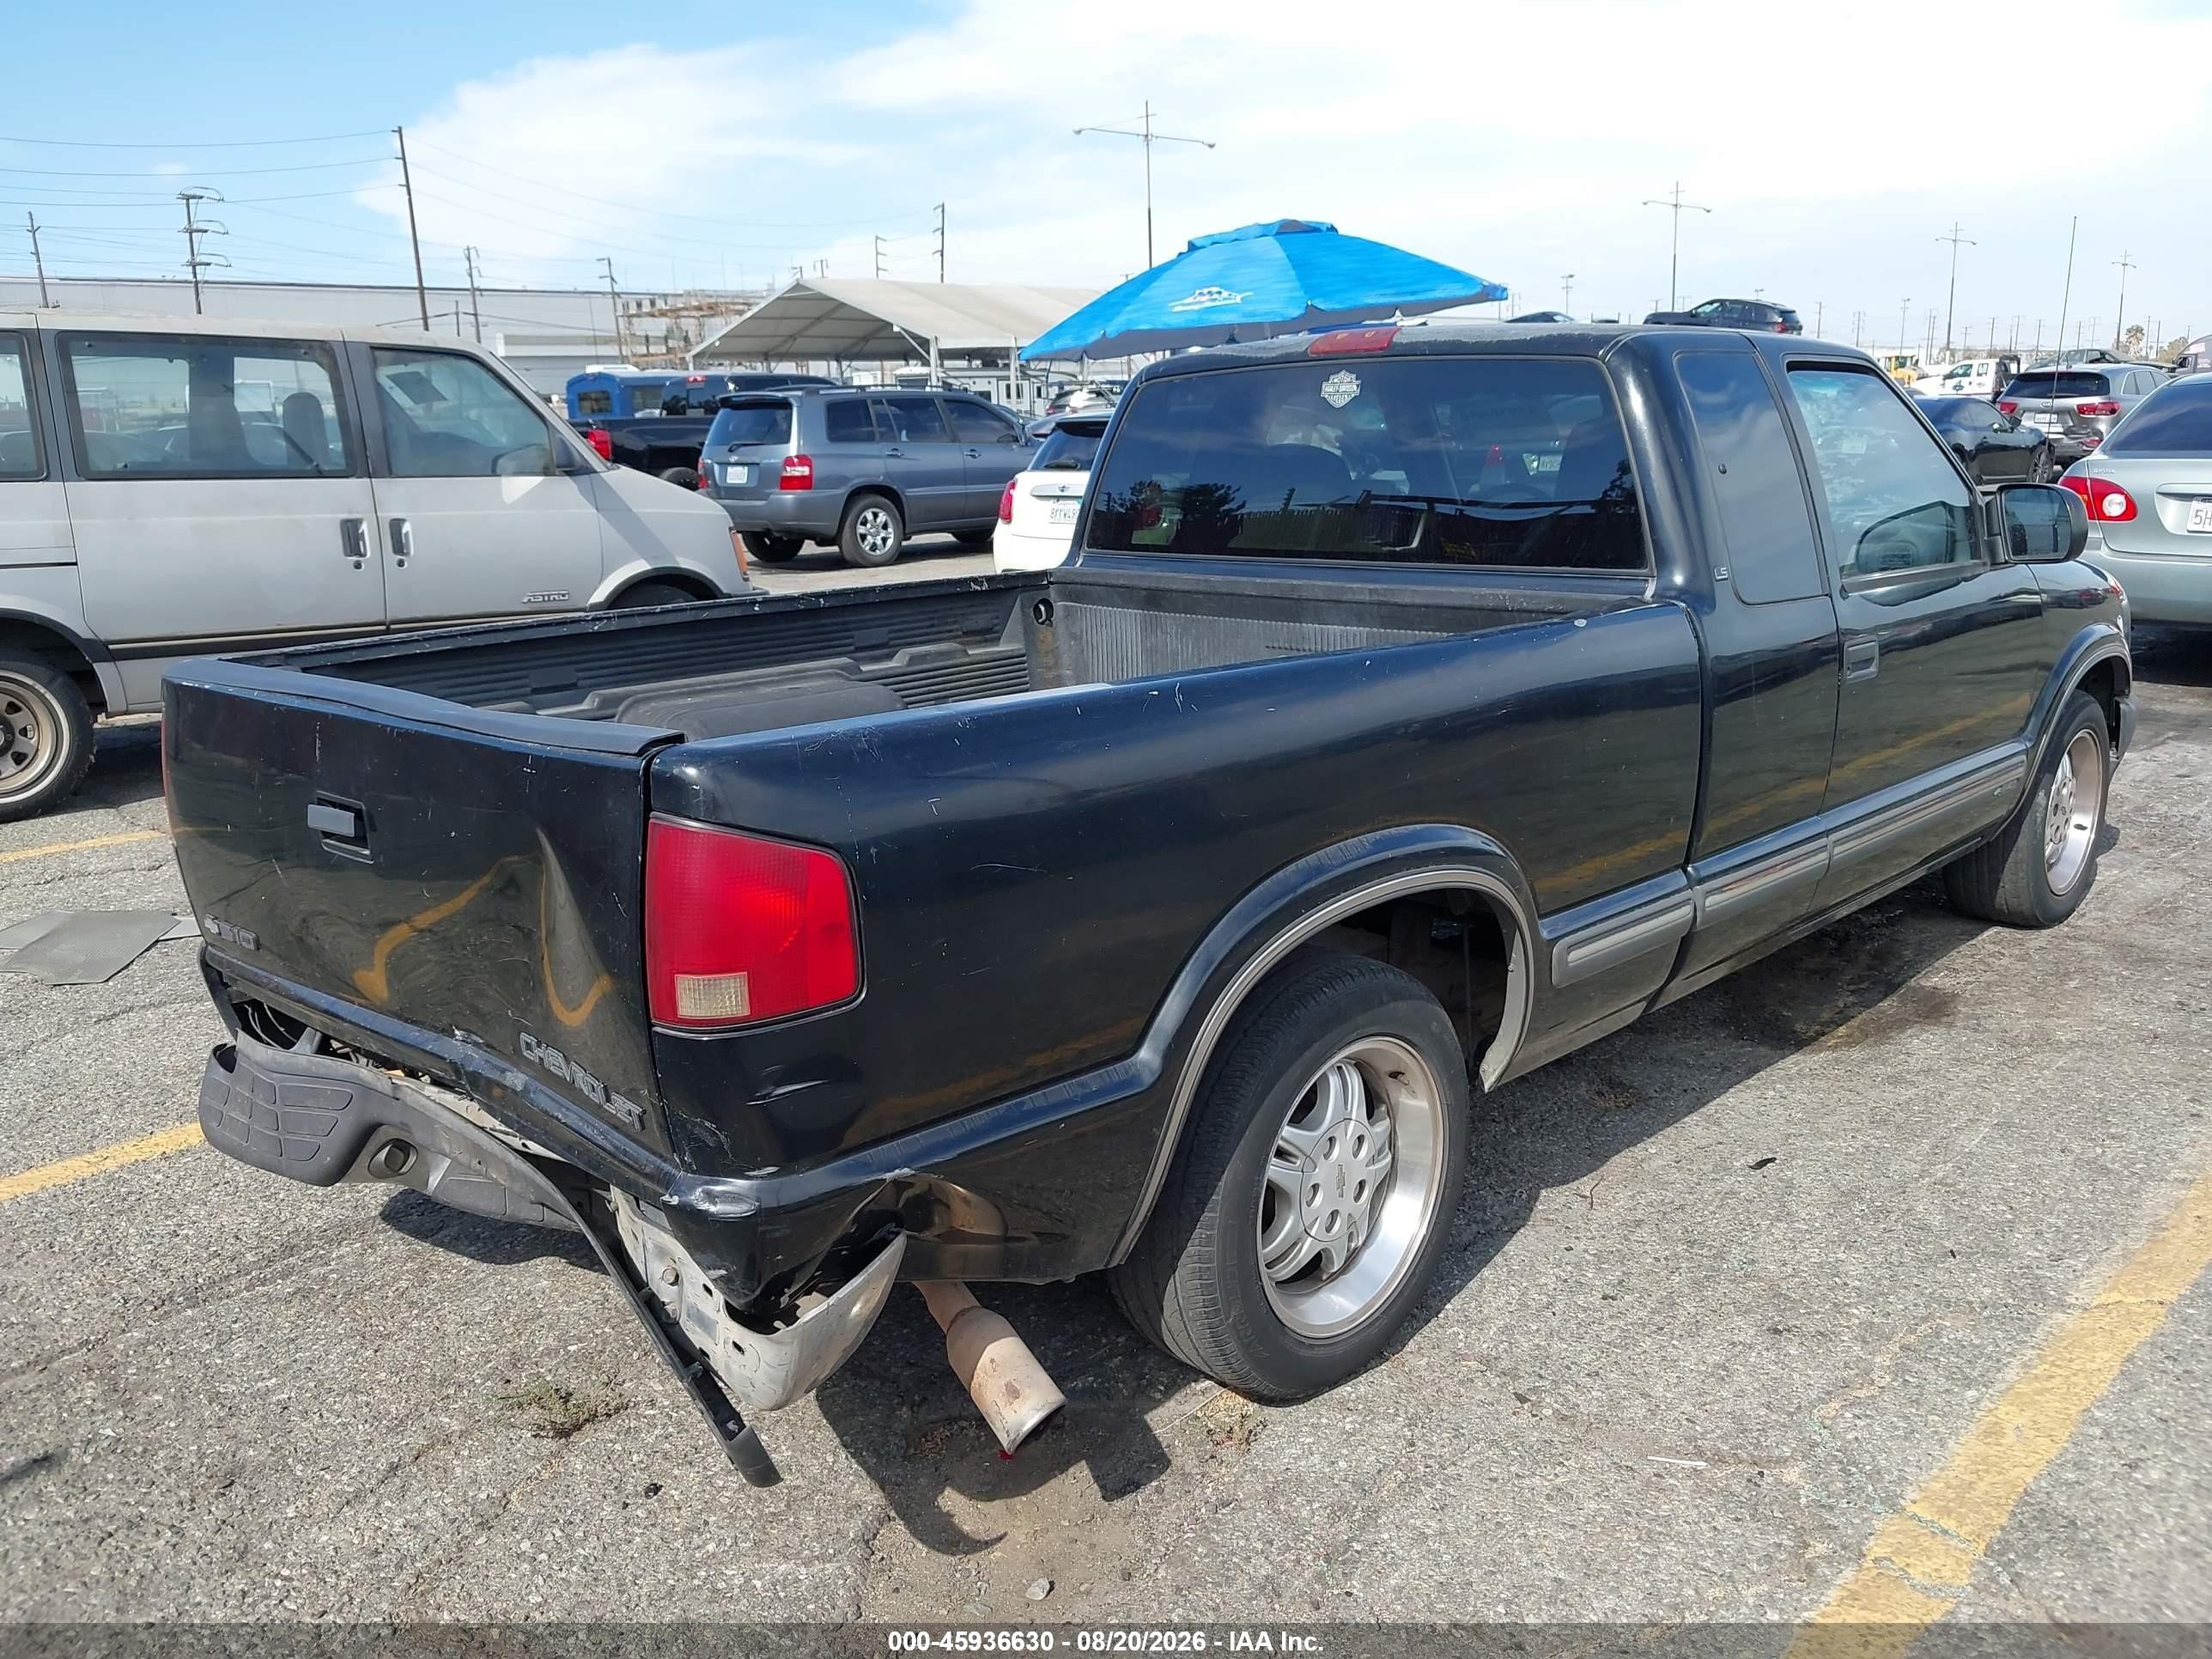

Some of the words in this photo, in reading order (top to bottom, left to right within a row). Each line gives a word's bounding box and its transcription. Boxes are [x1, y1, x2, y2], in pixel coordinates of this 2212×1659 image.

[1714, 566, 1729, 581] LS
[521, 590, 569, 603] ASTRO
[520, 1031, 646, 1133] CHEVROLET
